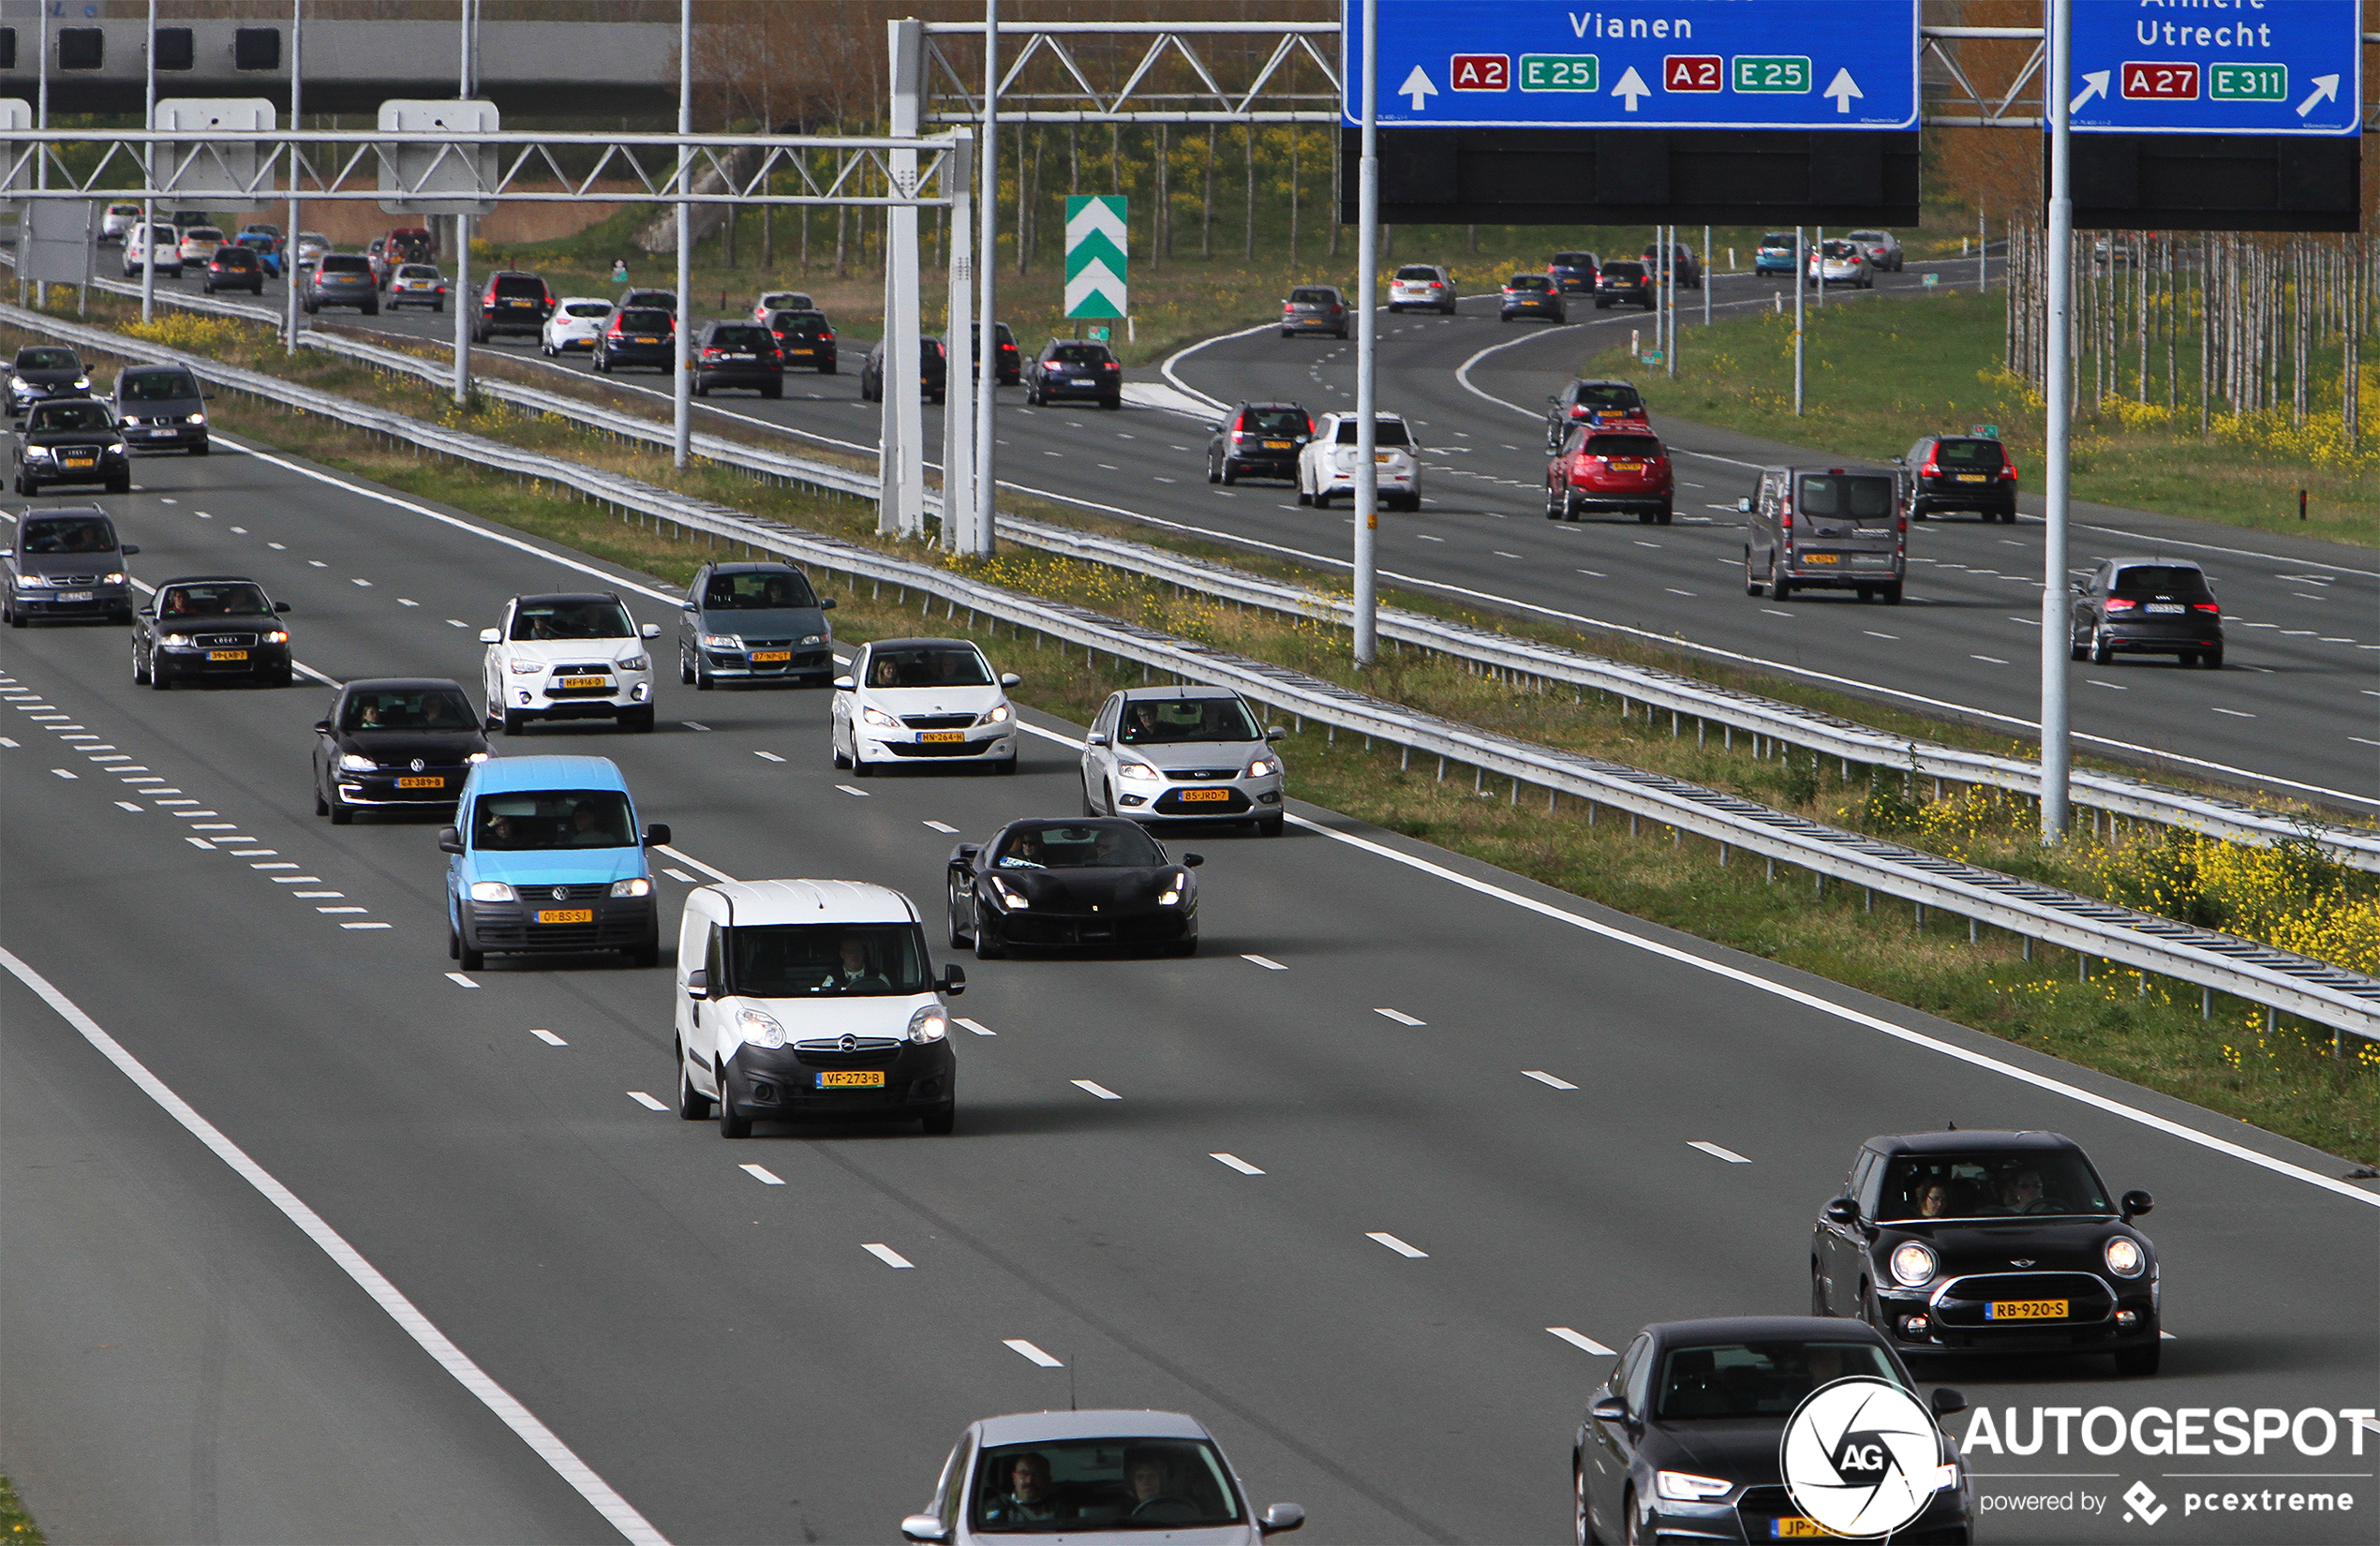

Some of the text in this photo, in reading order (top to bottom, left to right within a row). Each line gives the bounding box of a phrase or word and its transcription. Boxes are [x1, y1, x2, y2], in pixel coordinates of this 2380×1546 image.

[1569, 12, 1691, 38] Vianen
[2137, 20, 2270, 47] Utrecht
[1459, 62, 1503, 84] A2
[1672, 63, 1716, 85] A2
[2129, 69, 2194, 93] A27
[401, 778, 440, 786] GX-389-B
[1185, 791, 1226, 800] 85-JRD-7
[544, 912, 587, 921] 01-BS-SJ
[827, 1073, 880, 1084] VF-273-B
[1997, 1302, 2064, 1316] RB-920-S
